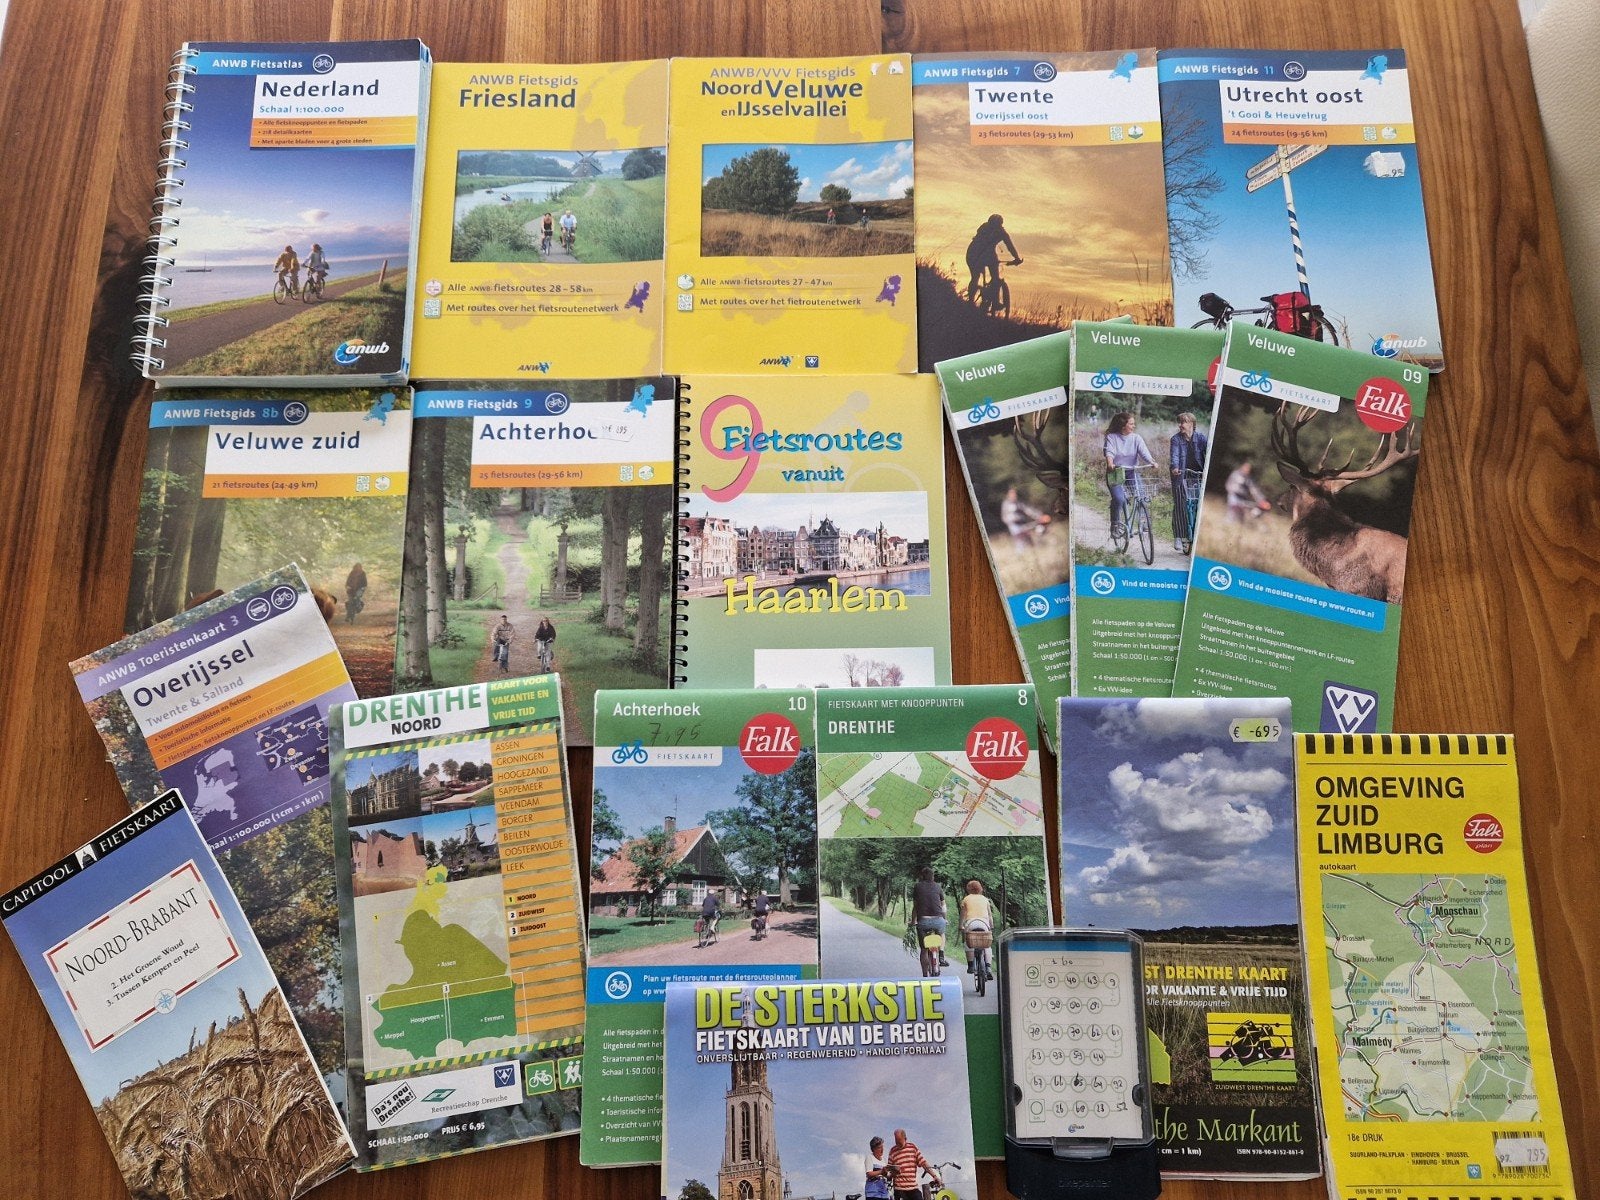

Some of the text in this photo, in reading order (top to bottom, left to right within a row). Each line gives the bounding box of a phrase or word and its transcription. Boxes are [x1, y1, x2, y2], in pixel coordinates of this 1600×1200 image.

[212, 59, 303, 69] ANWB Fietsatlas
[1175, 66, 1273, 76] ANWB Fietsgids 11
[710, 66, 856, 81] ANWB/VVV Fietsgids
[925, 67, 1020, 78] ANWB Fietsgids 7
[262, 80, 379, 97] Nederland
[470, 75, 578, 88] ANWB Fietsgids
[702, 79, 862, 98] Noord Veluwe
[460, 88, 575, 108] Friesland
[975, 89, 1054, 104] Twente
[1227, 87, 1363, 103] Utrecht oost
[721, 101, 847, 117] en IJsselvallei
[976, 112, 1024, 121] Overijssel
[1243, 129, 1284, 137] fietsroutes
[1287, 130, 1310, 138] (19-56
[1312, 130, 1328, 138] km)
[1091, 331, 1141, 347] Veluwe
[1248, 333, 1296, 357] Veluwe
[1382, 336, 1427, 348] anwb
[345, 342, 389, 354] anwb
[955, 363, 1006, 383] Veluwe
[1403, 369, 1422, 384] 09
[1132, 381, 1185, 390] FIETSKAART
[428, 399, 532, 411] ANWB Fietsgids 9
[1358, 385, 1410, 418] Falk
[164, 408, 278, 420] ANWB Fietsgids 8b
[216, 431, 360, 449] Veluwe zuid
[701, 394, 903, 503] 9 Fietsroutes
[782, 466, 844, 482] vanuit
[723, 575, 908, 615] Haarlem
[1238, 579, 1253, 587] Vind
[1266, 586, 1293, 599] mooiste
[1295, 592, 1317, 604] routes
[1319, 600, 1328, 608] op
[1329, 602, 1374, 618] www.route.nl
[99, 615, 239, 687] ANWB Toeristenkaart 3
[133, 639, 254, 707] Overijssel
[491, 677, 547, 691] KAART VOOR
[146, 676, 244, 727] Twente & Salland
[491, 690, 548, 705] VAKANTIE EN
[828, 690, 1027, 709] FIETSKAART MET KNOOPPUNTEN 8
[350, 685, 481, 727] DRENTHE
[493, 707, 535, 720] VRIJE TIJD
[613, 697, 806, 716] Achterhoek 10
[392, 717, 441, 735] NOORD
[828, 721, 895, 734] DRENTHE
[1233, 727, 1239, 738] €
[496, 741, 519, 751] ASSEN
[743, 727, 798, 752] Falk
[970, 732, 1026, 758] Falk
[497, 752, 544, 765] GRONINGEN
[498, 766, 548, 780] HOOGEZAND
[499, 782, 543, 796] SAPPEMEER
[1316, 777, 1464, 798] OMGEVING
[500, 798, 540, 811] VEENDAM
[502, 814, 533, 826] BORGER
[1317, 805, 1379, 826] ZUID
[504, 830, 530, 840] BEILEN
[1466, 819, 1502, 837] Falk
[505, 840, 563, 856] OOSTERWOLDE
[1318, 833, 1443, 854] LIMBURG
[2, 796, 177, 912] CAPITOOL FIETSKAART
[507, 863, 524, 871] LEEK
[517, 893, 536, 901] NOORD
[1435, 907, 1478, 917] Monschau
[65, 887, 199, 982] NOORD-BRABANT
[120, 971, 134, 983] Het
[136, 954, 162, 975] Groene
[162, 939, 184, 956] Woud
[106, 944, 200, 1007] 3. Tussen Kempen en Peel
[735, 974, 797, 983] fietsrouteplanner
[1166, 966, 1233, 980] DRENTHE
[1239, 967, 1287, 981] KAART
[1162, 985, 1216, 996] VAKANTIE
[1220, 986, 1227, 996] &
[1230, 986, 1260, 997] VRIJE
[1265, 987, 1287, 997] TIJD
[696, 980, 944, 1029] DE STERKSTE
[1162, 998, 1230, 1007] fietsknooppunten
[384, 1031, 404, 1040] Meppel
[616, 1029, 651, 1037] fietspaden
[697, 1022, 946, 1051] FIETSKAART VAN DE REGIO
[1352, 1037, 1392, 1049] Malmédy
[697, 1046, 946, 1063] ONVERSLIJTBAAR REGENWEREND HANDIG FORMAAT
[374, 1086, 408, 1115] Da's nou
[379, 1092, 413, 1122] Drenthe!
[432, 1095, 507, 1113] Recreatieschap Drenthe
[368, 1138, 396, 1148] SCHAAL
[398, 1132, 429, 1143] 1:50.000
[442, 1124, 460, 1134] PRIJS
[470, 1122, 485, 1131] 6,95
[1197, 1109, 1302, 1145] Markant
[1348, 1134, 1360, 1142] 18e
